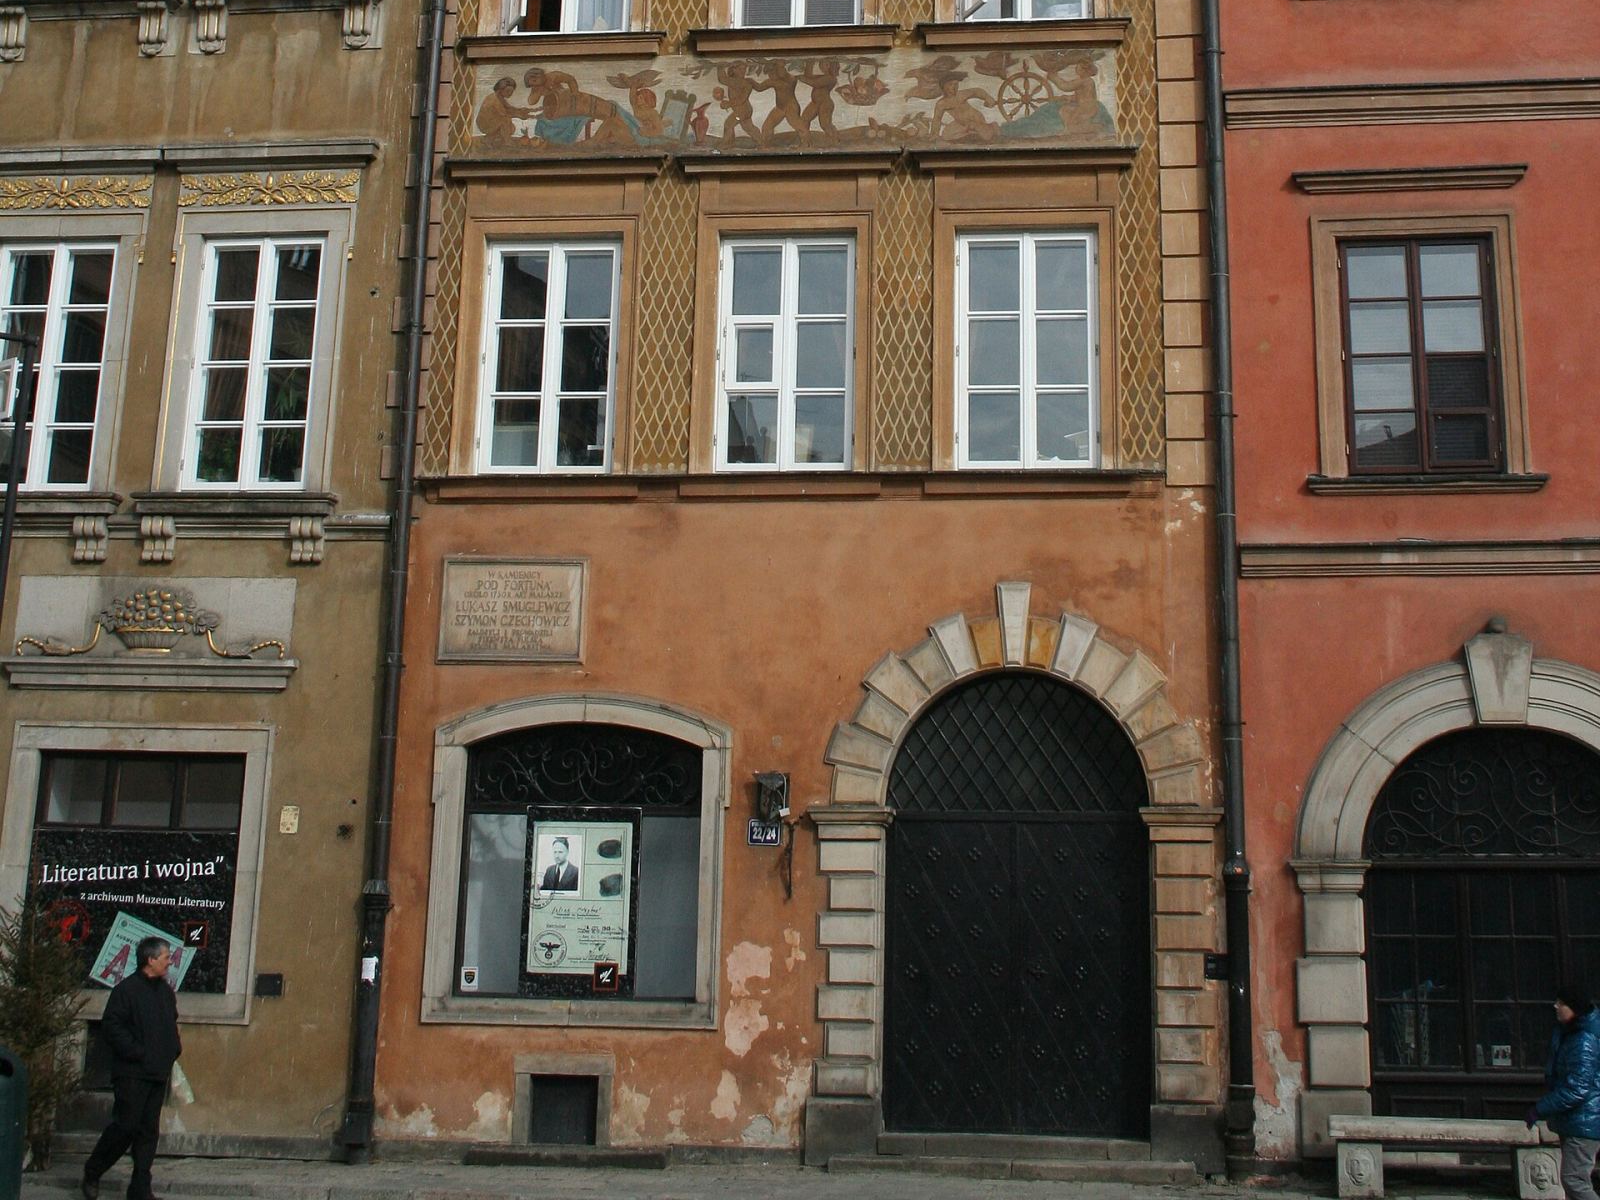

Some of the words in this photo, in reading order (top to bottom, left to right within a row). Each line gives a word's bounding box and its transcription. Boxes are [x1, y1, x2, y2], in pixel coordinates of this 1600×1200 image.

[488, 571, 496, 579] W
[502, 601, 571, 613] SMUGLEWICZ
[454, 614, 497, 627] SZYMON
[500, 615, 570, 627] CZECHOWICZ
[752, 826, 777, 842] 22/24
[144, 860, 150, 878] i
[80, 892, 86, 900] z
[88, 891, 134, 903] archiwum
[136, 894, 176, 906] Muzeum
[178, 896, 226, 911] Literatury
